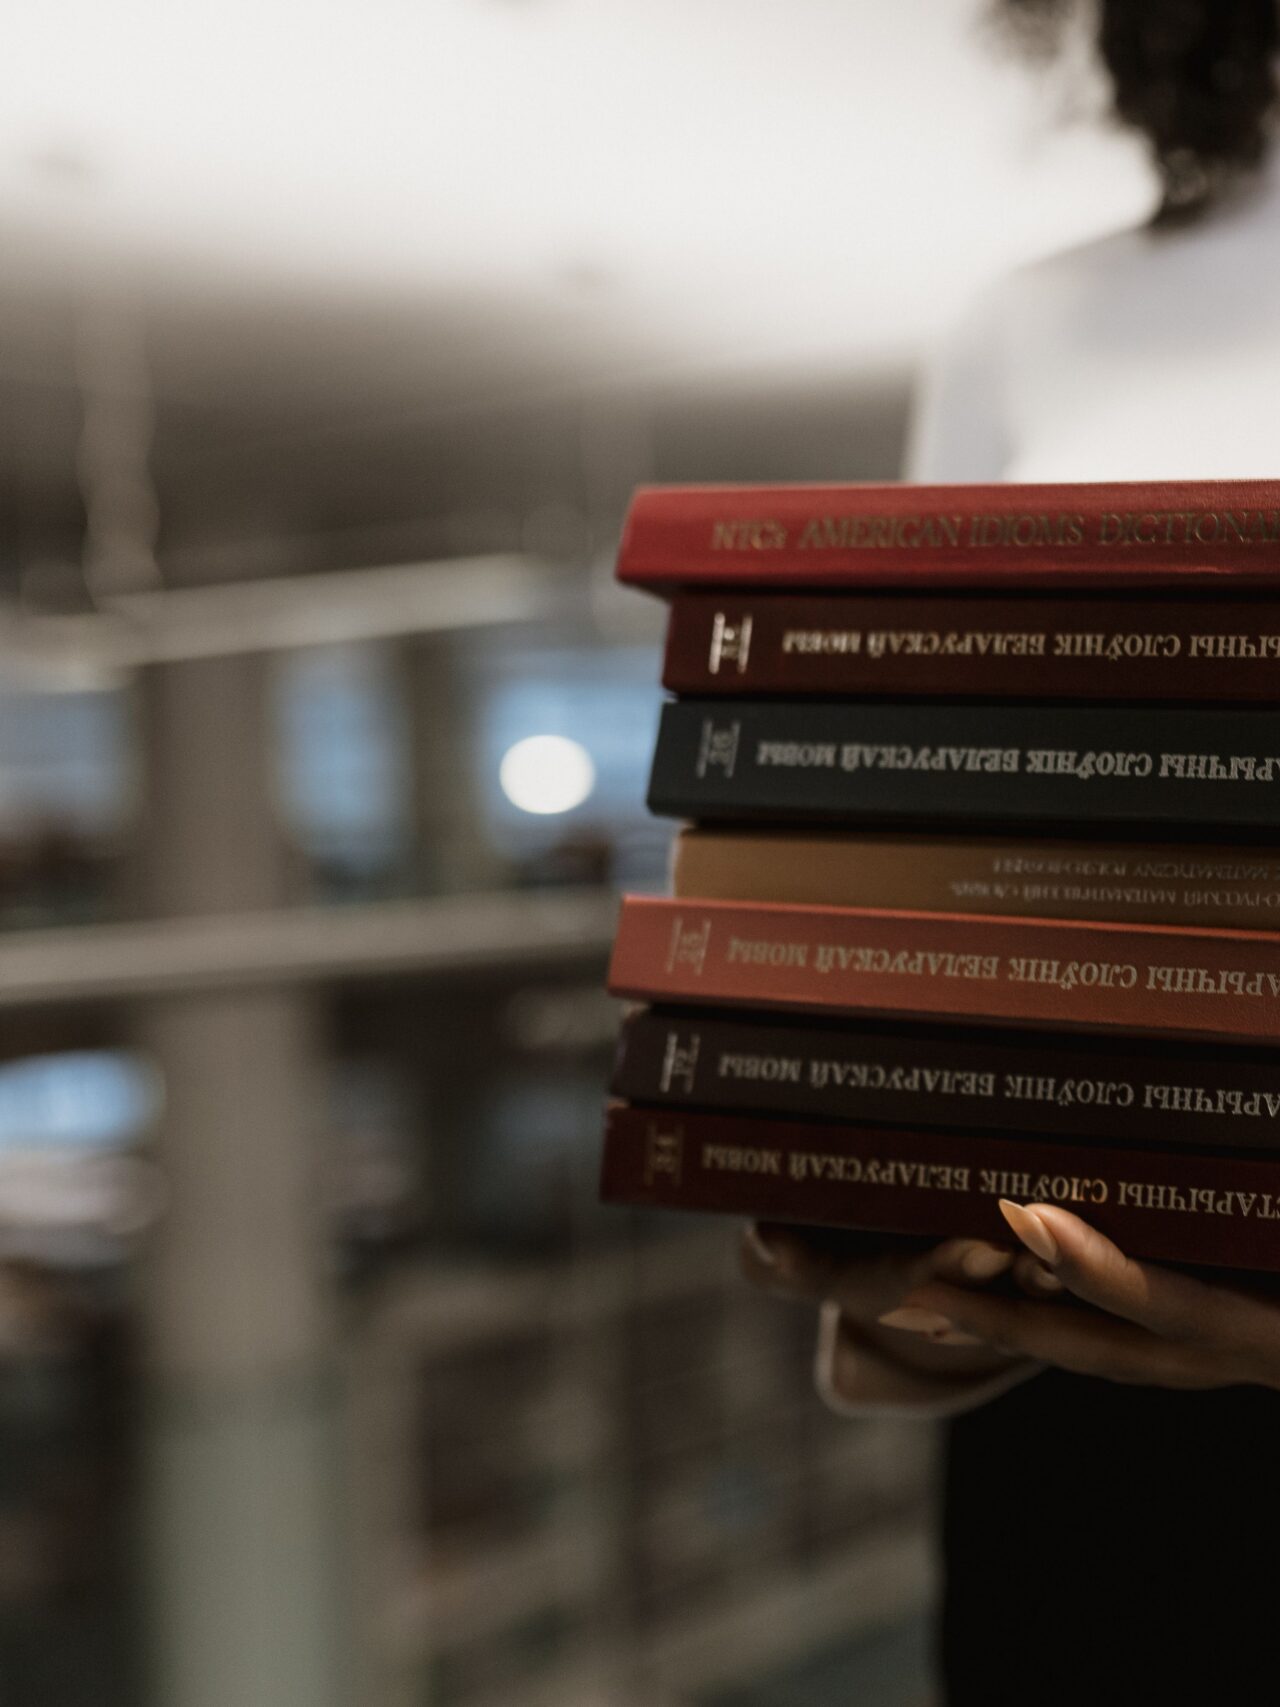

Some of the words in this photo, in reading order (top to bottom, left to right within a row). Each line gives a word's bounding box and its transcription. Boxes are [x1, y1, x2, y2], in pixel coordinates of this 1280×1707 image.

[800, 514, 962, 549] AMERICAN
[969, 512, 1085, 546] IDIOMS
[866, 630, 1046, 658] БЕЛАРУСКАЙ
[1053, 632, 1181, 661] СЛОЎНІК
[840, 742, 1019, 772] БЕЛАРУСКАЙ
[1026, 748, 1152, 780] СЛОЎНІК
[727, 935, 808, 967] МОВЫ
[814, 944, 1000, 979] БЕЛАРУСКАЙ
[1007, 955, 1137, 990] СЛОЎНІК
[717, 1053, 802, 1083] МОВЫ
[809, 1058, 995, 1096] БЕЛАРУСКАЙ
[1003, 1073, 1134, 1106] СЛОЎНІК
[701, 1143, 784, 1176] МОВЫ
[788, 1150, 970, 1191] БЕЛАРУСКАЙ
[980, 1167, 1108, 1203] СЛОЎНІК
